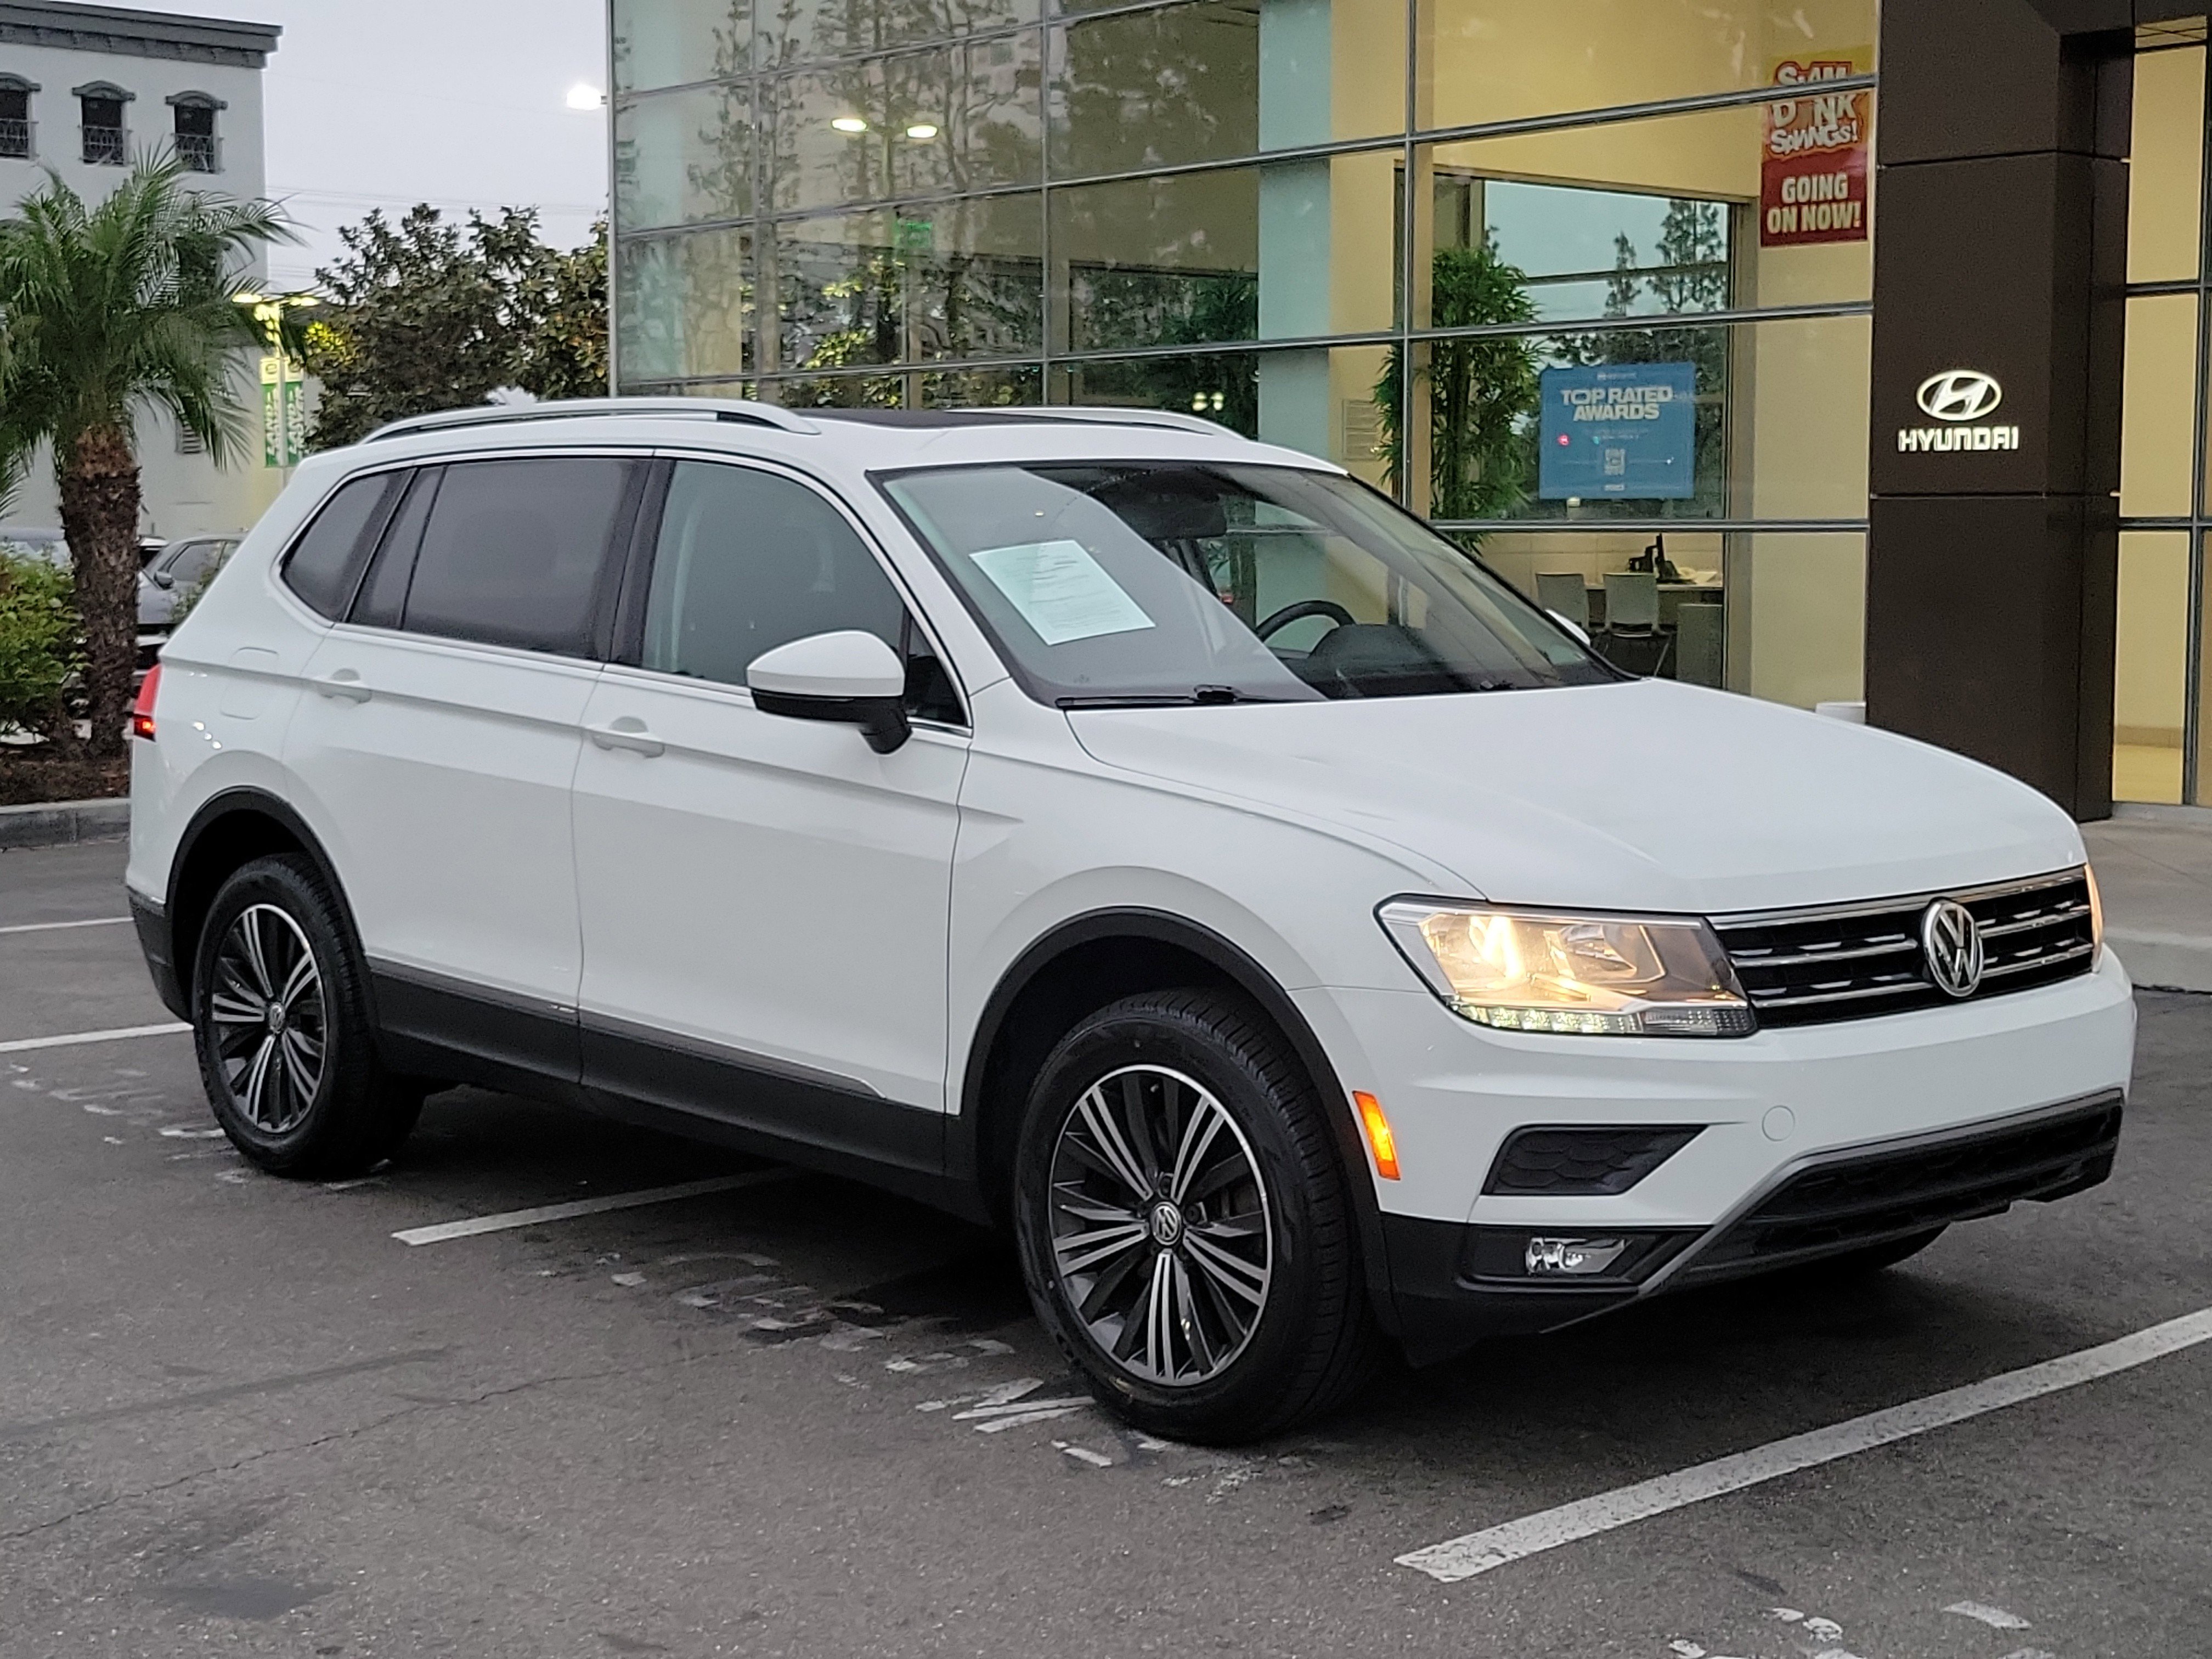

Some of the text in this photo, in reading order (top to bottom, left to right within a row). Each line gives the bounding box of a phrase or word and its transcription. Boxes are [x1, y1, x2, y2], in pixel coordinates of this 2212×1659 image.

[1781, 172, 1848, 204] GOING
[1767, 201, 1862, 234] ON NOW!
[1560, 385, 1673, 405] TOP RATED
[1573, 402, 1660, 422] AWARDS
[1898, 426, 2019, 452] HYUNDAI
